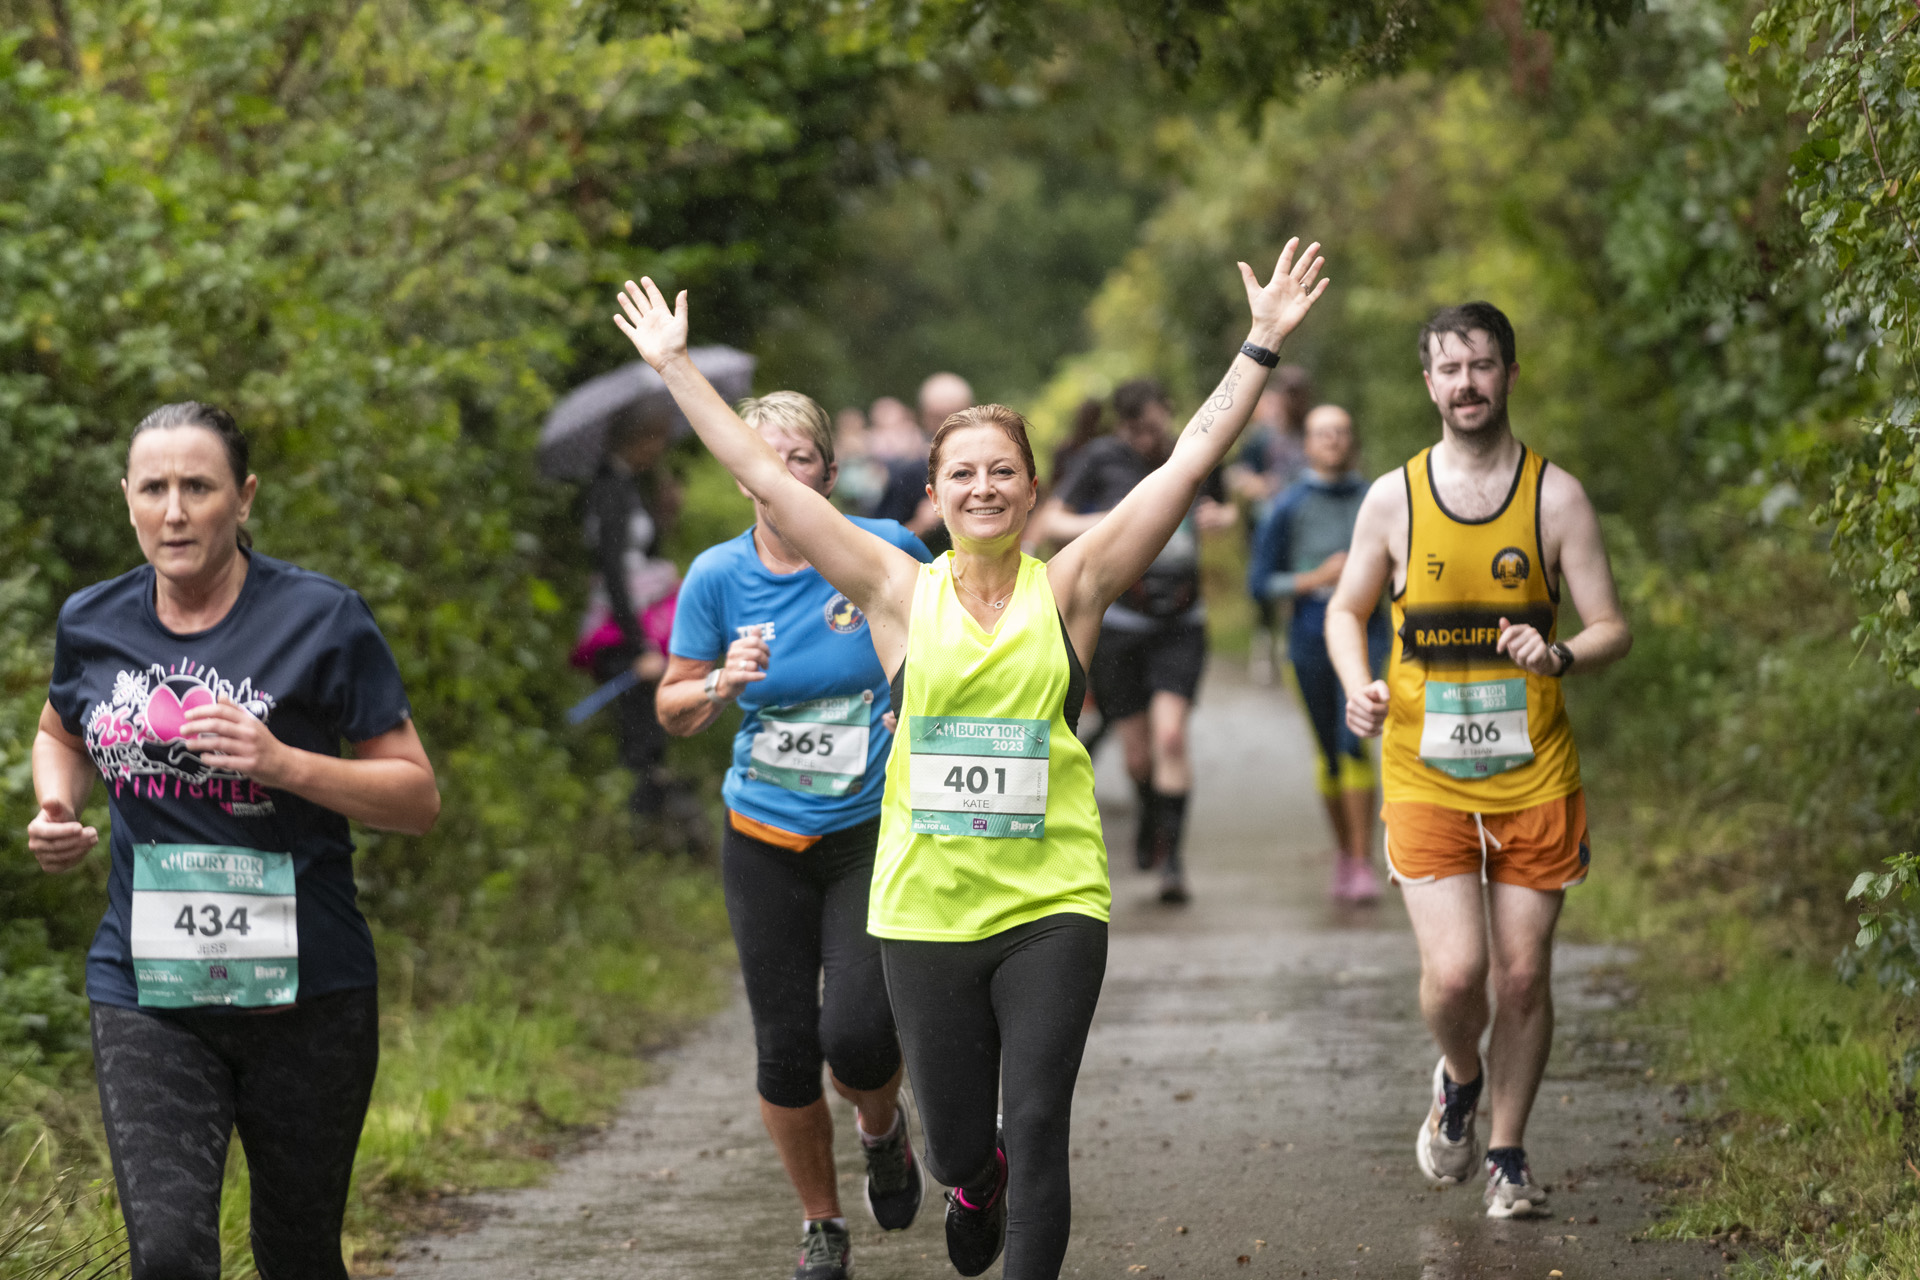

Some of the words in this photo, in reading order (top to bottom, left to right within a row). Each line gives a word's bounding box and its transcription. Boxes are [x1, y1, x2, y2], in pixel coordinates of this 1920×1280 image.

[1486, 685, 1504, 696] 10K
[1482, 697, 1507, 708] 2023
[958, 724, 993, 738] BURY
[998, 726, 1023, 739] 10K
[1450, 720, 1501, 745] 406
[778, 730, 834, 756] 365
[992, 740, 1024, 751] 2023
[943, 765, 1006, 795] 401
[963, 799, 990, 809] KATE
[927, 823, 939, 831] FOR
[1010, 821, 1036, 833] Bury
[185, 853, 229, 870] BURY
[234, 856, 261, 872] 10K
[227, 874, 264, 889] 2023
[174, 904, 251, 937] 434
[197, 943, 228, 955] JESS
[254, 965, 287, 980] Bury
[265, 987, 291, 1001] 434
